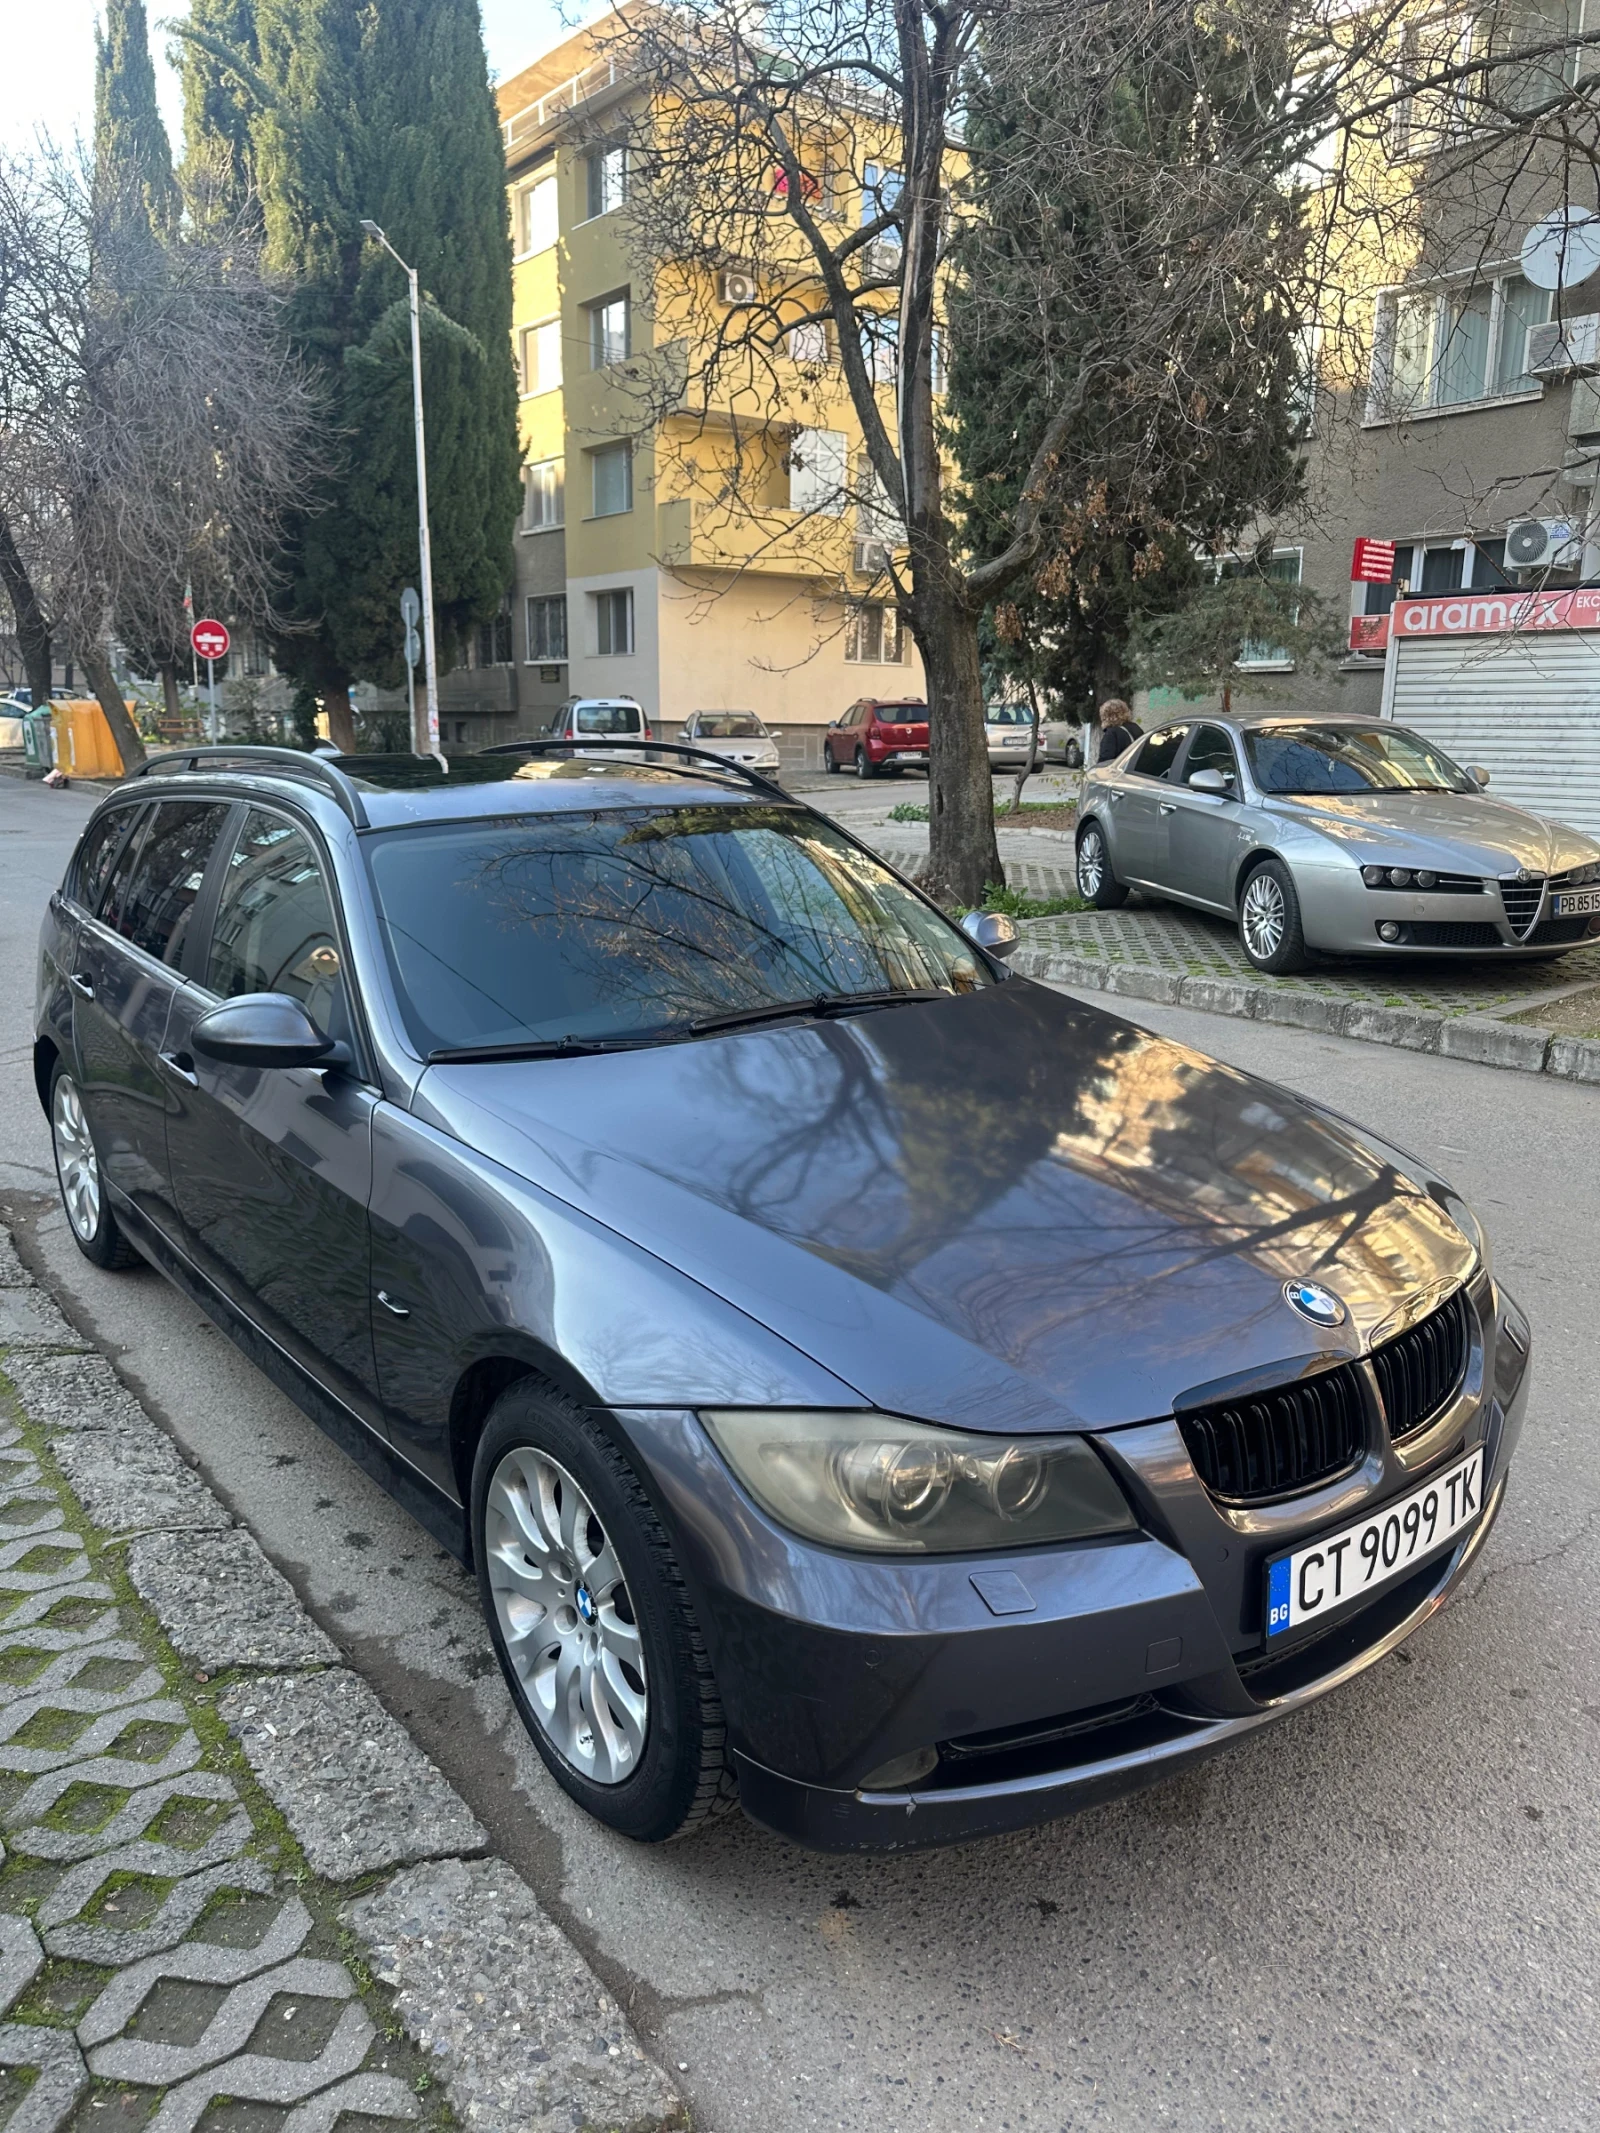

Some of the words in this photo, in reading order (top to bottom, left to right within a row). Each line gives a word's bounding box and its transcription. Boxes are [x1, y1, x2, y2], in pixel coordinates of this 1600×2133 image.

[1403, 598, 1562, 631] aramex
[1561, 896, 1576, 913] PB
[1299, 1536, 1351, 1611] CT
[1360, 1490, 1439, 1582] 9099
[1445, 1459, 1478, 1527] TK
[1270, 1603, 1288, 1625] BG
